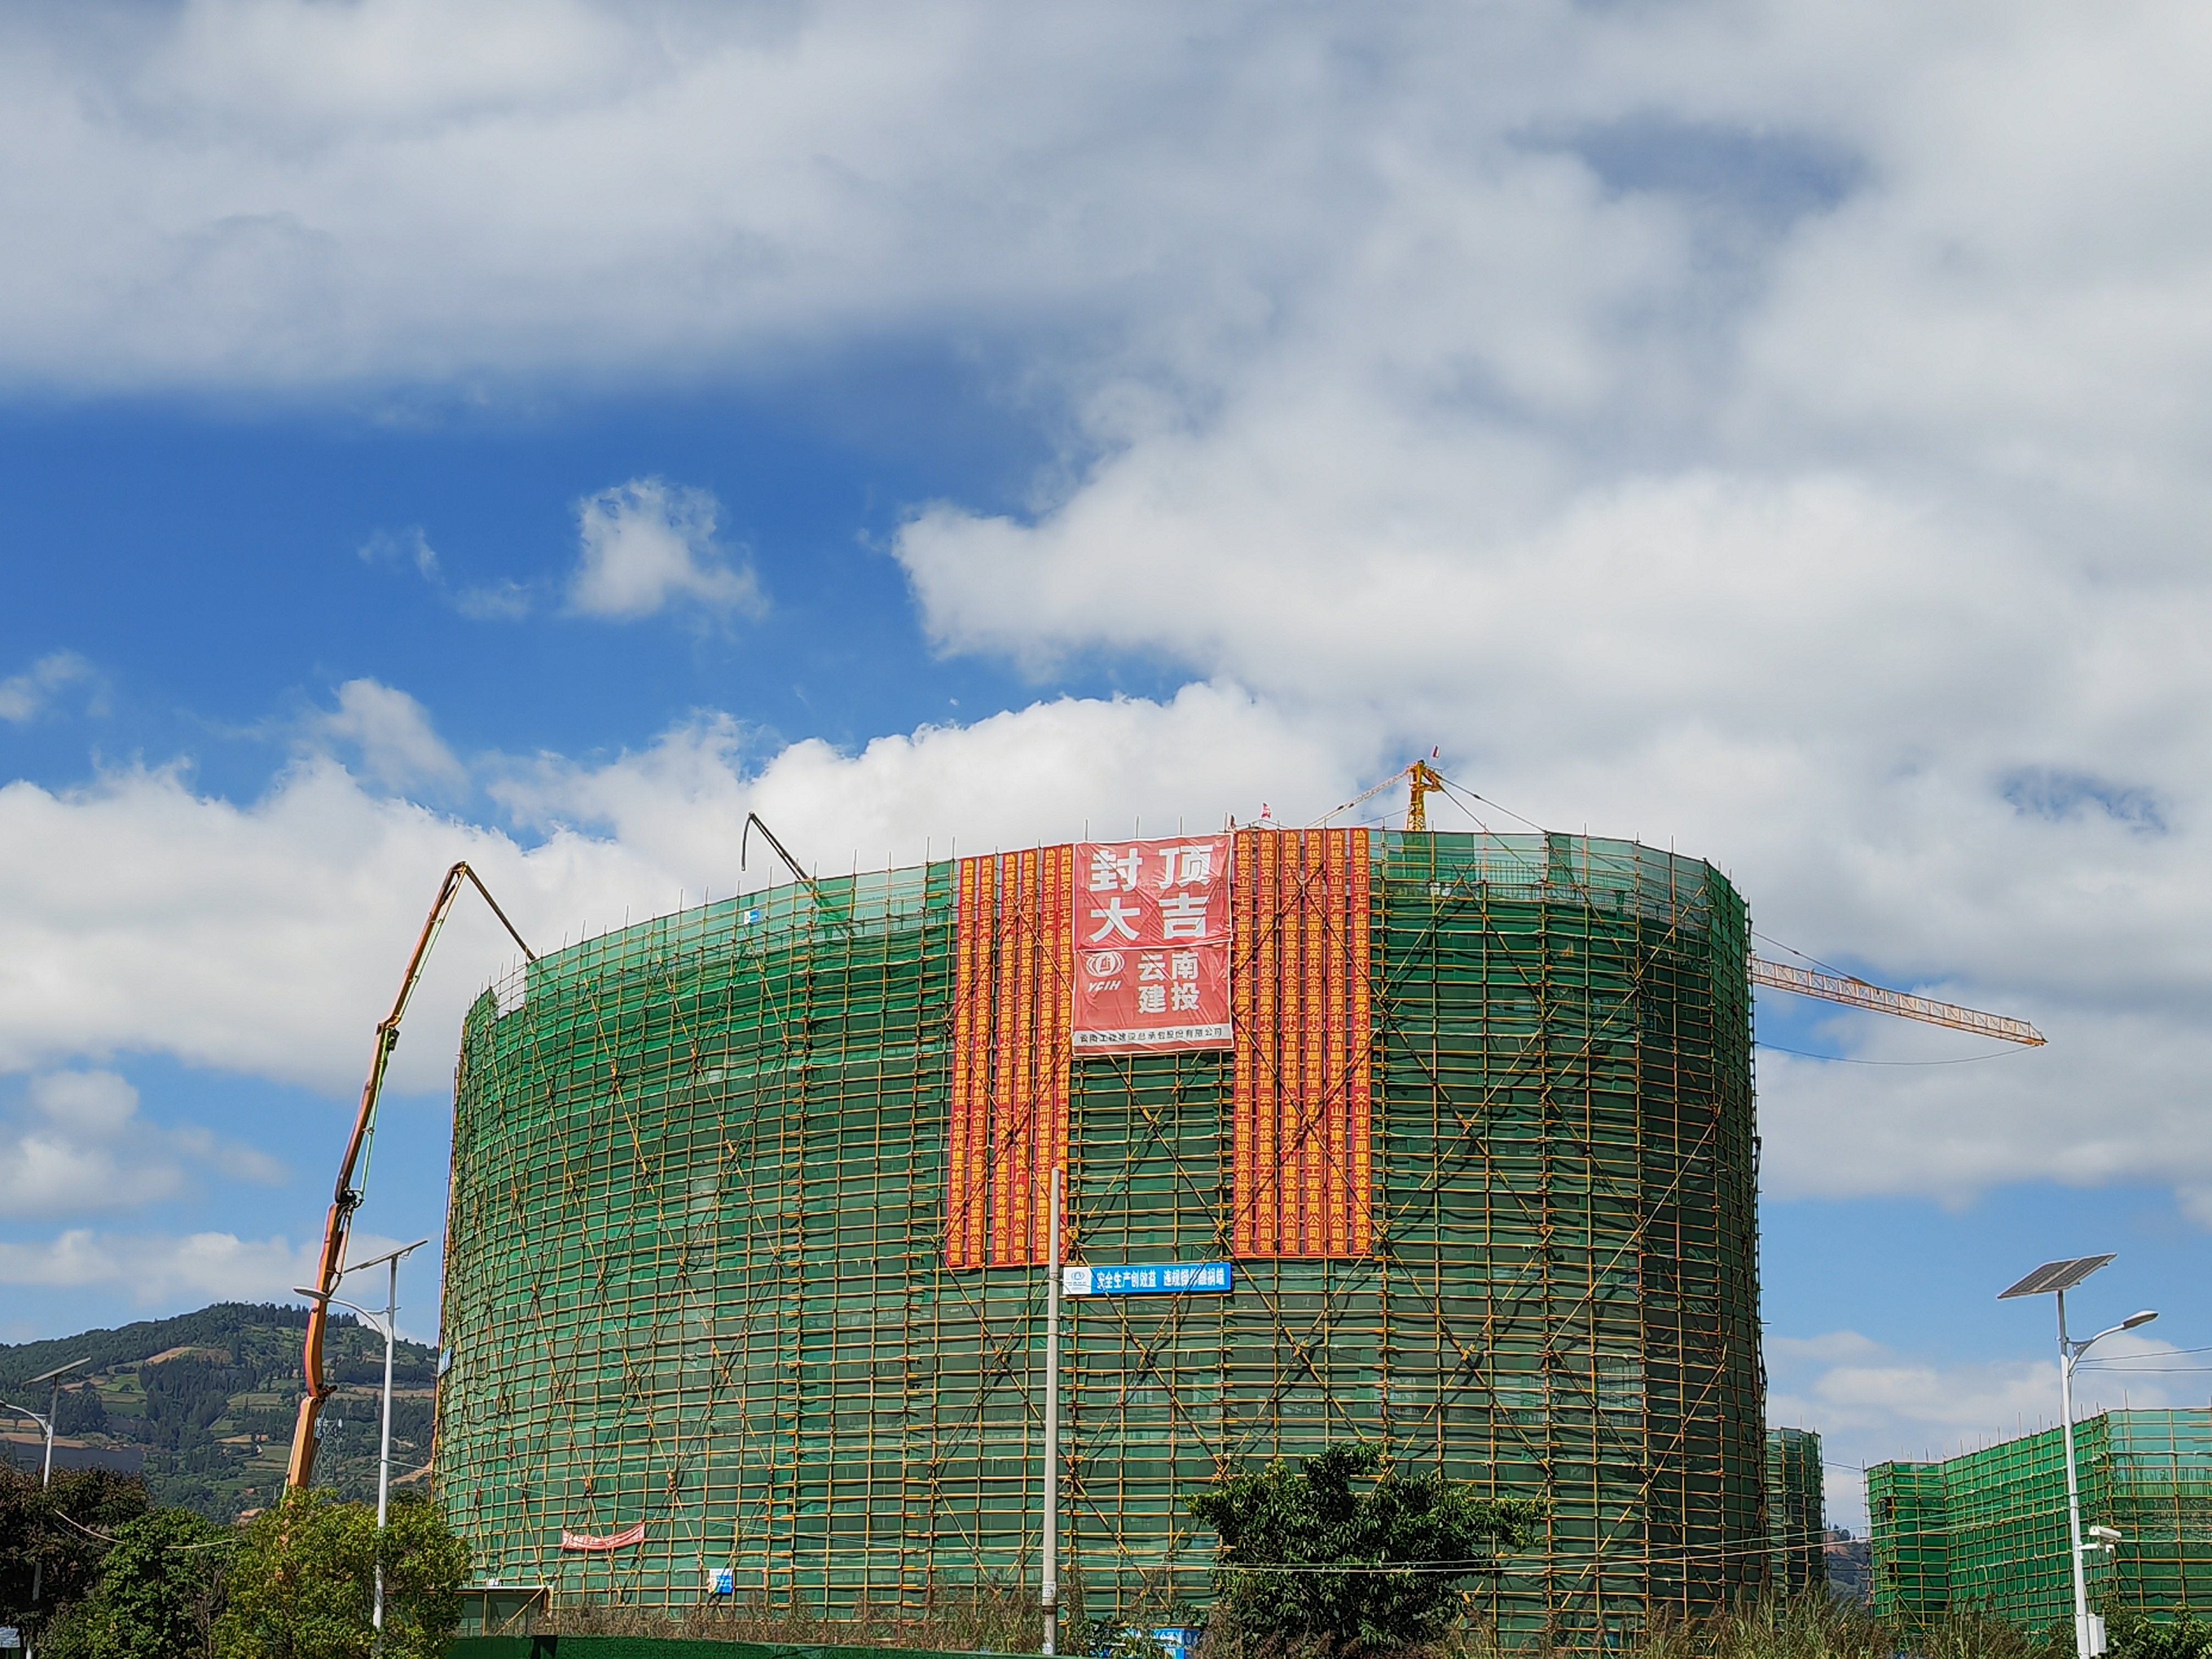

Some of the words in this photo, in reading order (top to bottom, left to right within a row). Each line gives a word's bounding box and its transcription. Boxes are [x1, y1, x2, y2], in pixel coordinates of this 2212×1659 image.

[1088, 844, 1213, 892] 封顶
[1088, 892, 1208, 942] 大吉
[1138, 952, 1198, 982] 云南
[1087, 980, 1121, 993] YCIH
[1138, 983, 1201, 1014] 建投
